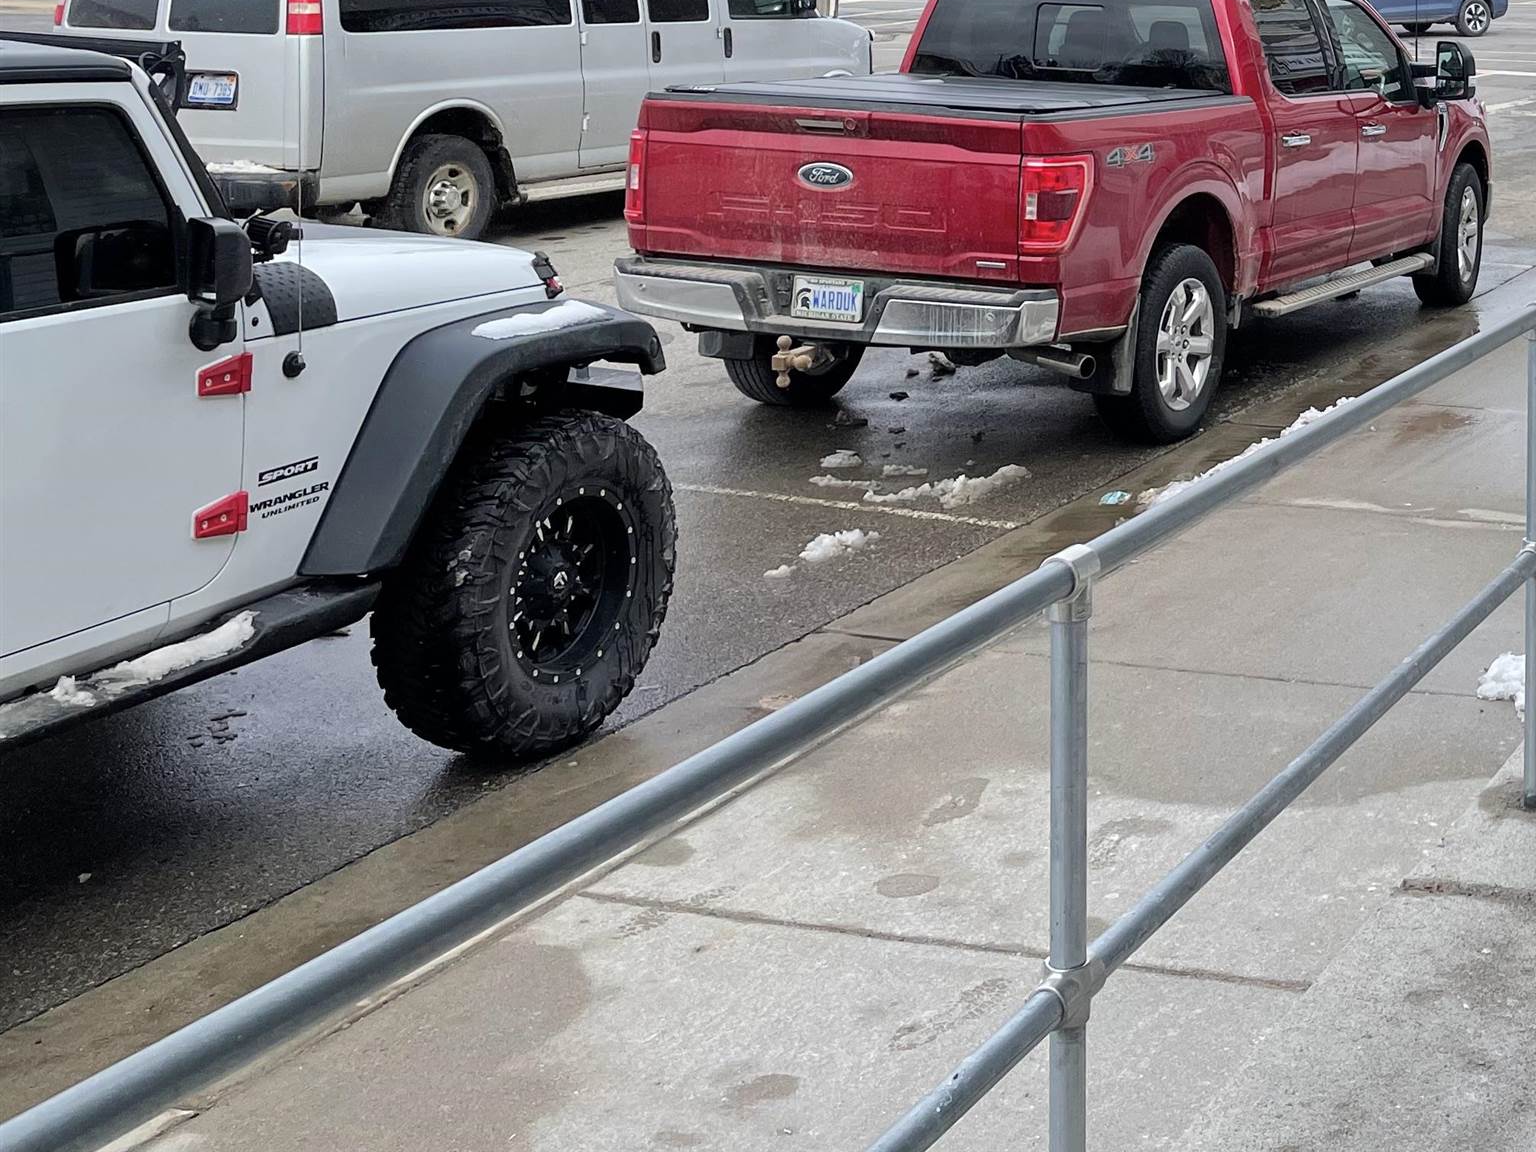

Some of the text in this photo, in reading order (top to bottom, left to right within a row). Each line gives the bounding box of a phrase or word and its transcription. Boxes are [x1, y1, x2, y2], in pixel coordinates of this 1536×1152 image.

[809, 167, 840, 183] Ford
[812, 289, 858, 313] WARDUK
[261, 461, 314, 482] SPORT
[249, 481, 330, 514] WRANGLER
[261, 495, 321, 519] UNLIMITED
